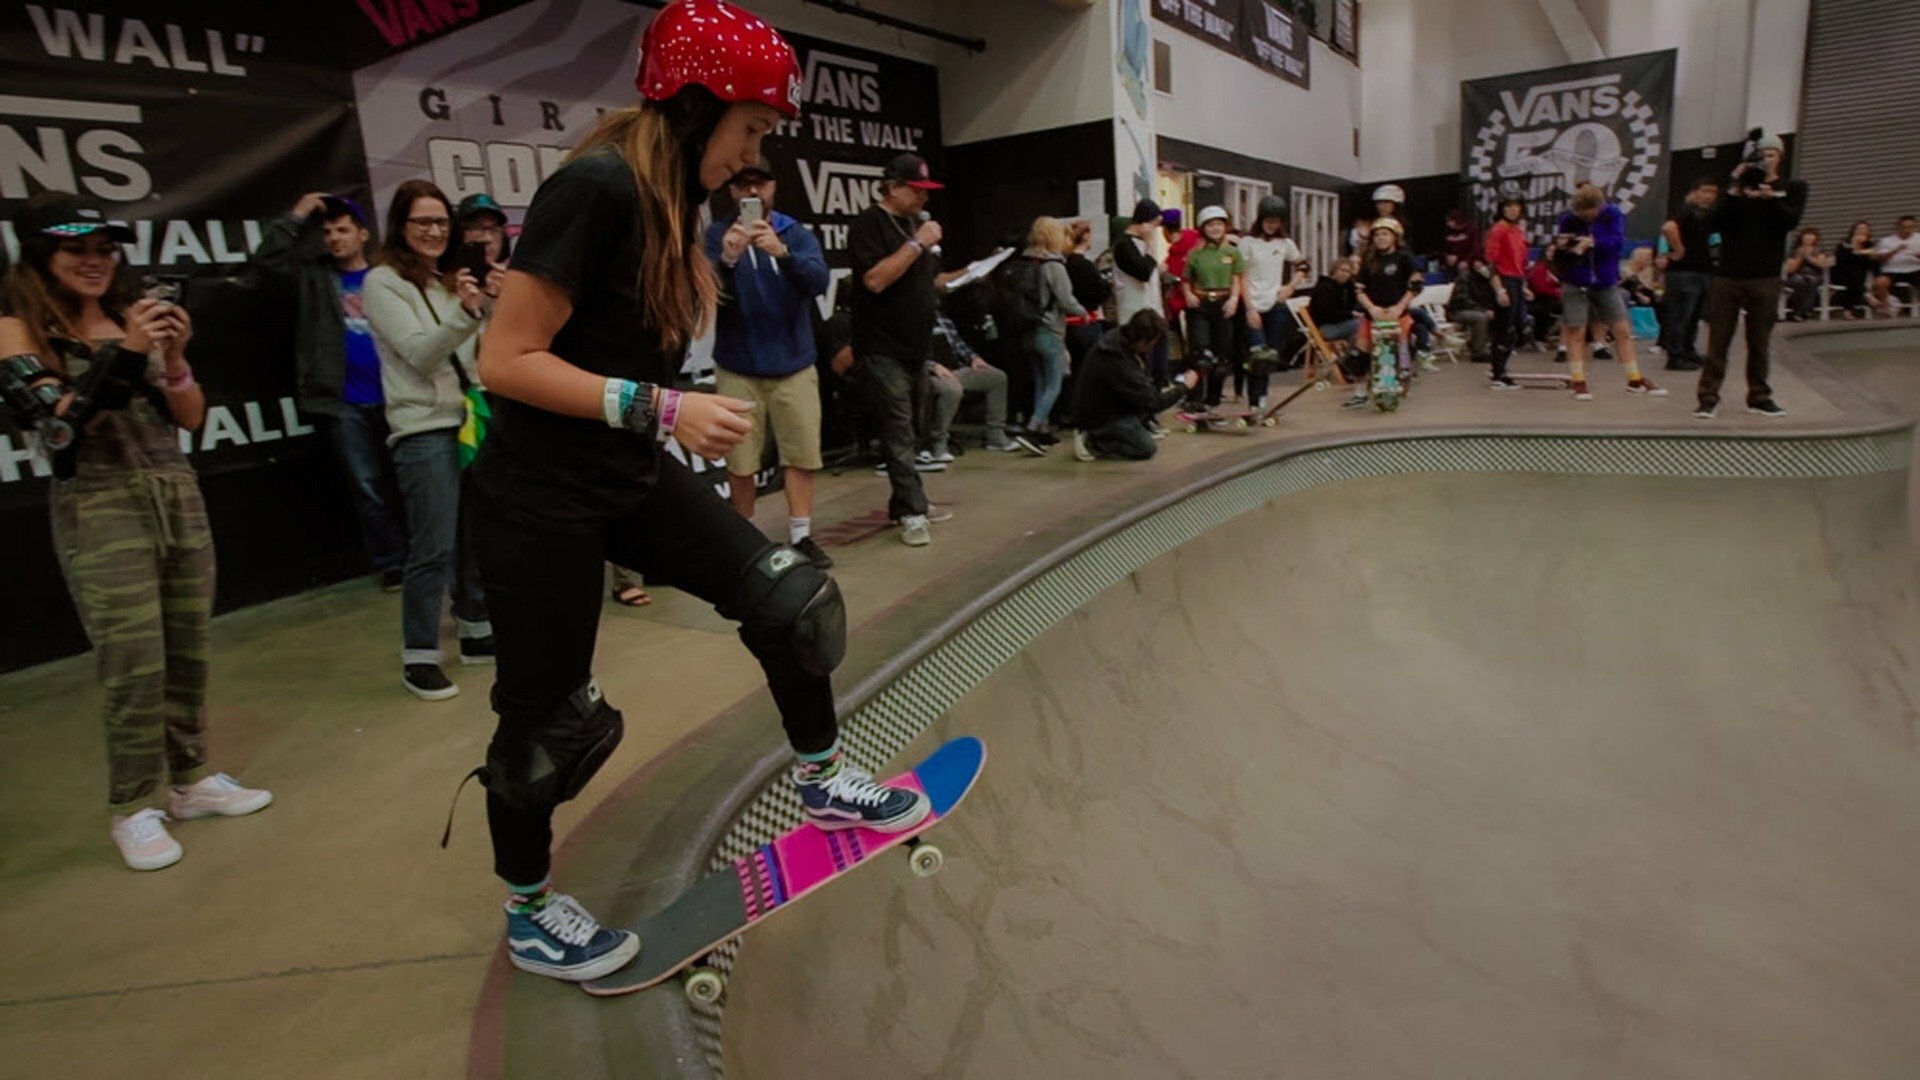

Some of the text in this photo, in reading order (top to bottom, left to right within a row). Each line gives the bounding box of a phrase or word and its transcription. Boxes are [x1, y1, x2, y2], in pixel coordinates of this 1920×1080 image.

[24, 4, 265, 77] WALL"
[419, 87, 605, 131] GIR
[1500, 74, 1622, 128] VANS
[810, 113, 855, 144] THE
[861, 120, 923, 151] WALL"
[178, 397, 314, 454] ALL
